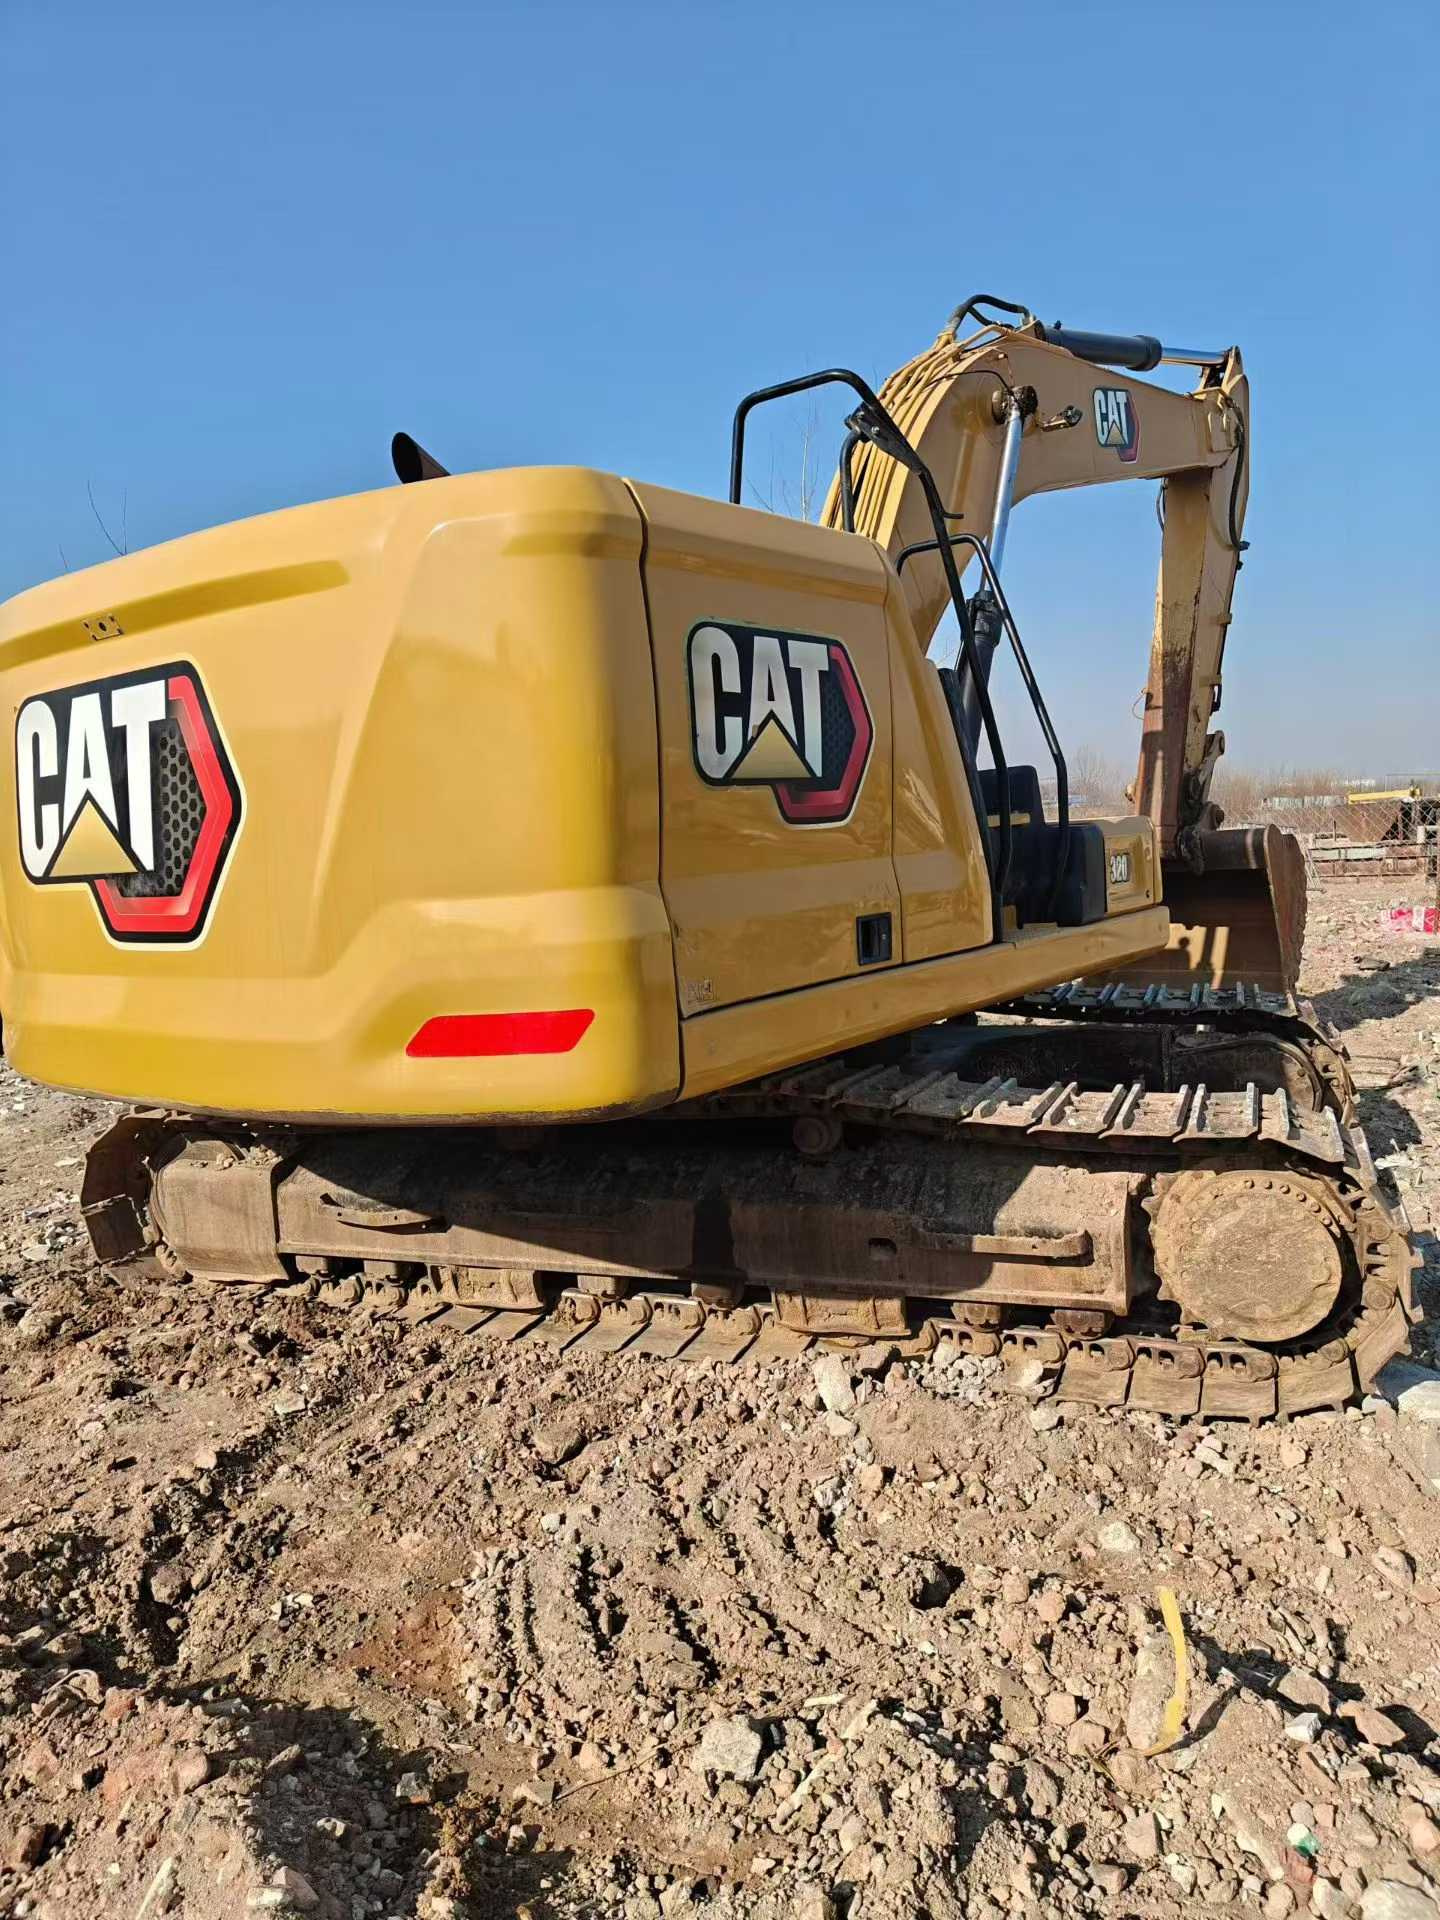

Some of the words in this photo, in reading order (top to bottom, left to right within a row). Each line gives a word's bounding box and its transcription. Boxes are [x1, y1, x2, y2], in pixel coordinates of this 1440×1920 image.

[1094, 389, 1129, 445] CAT
[691, 626, 829, 779] CAT
[16, 679, 166, 878] CAT
[1110, 855, 1127, 882] 320
